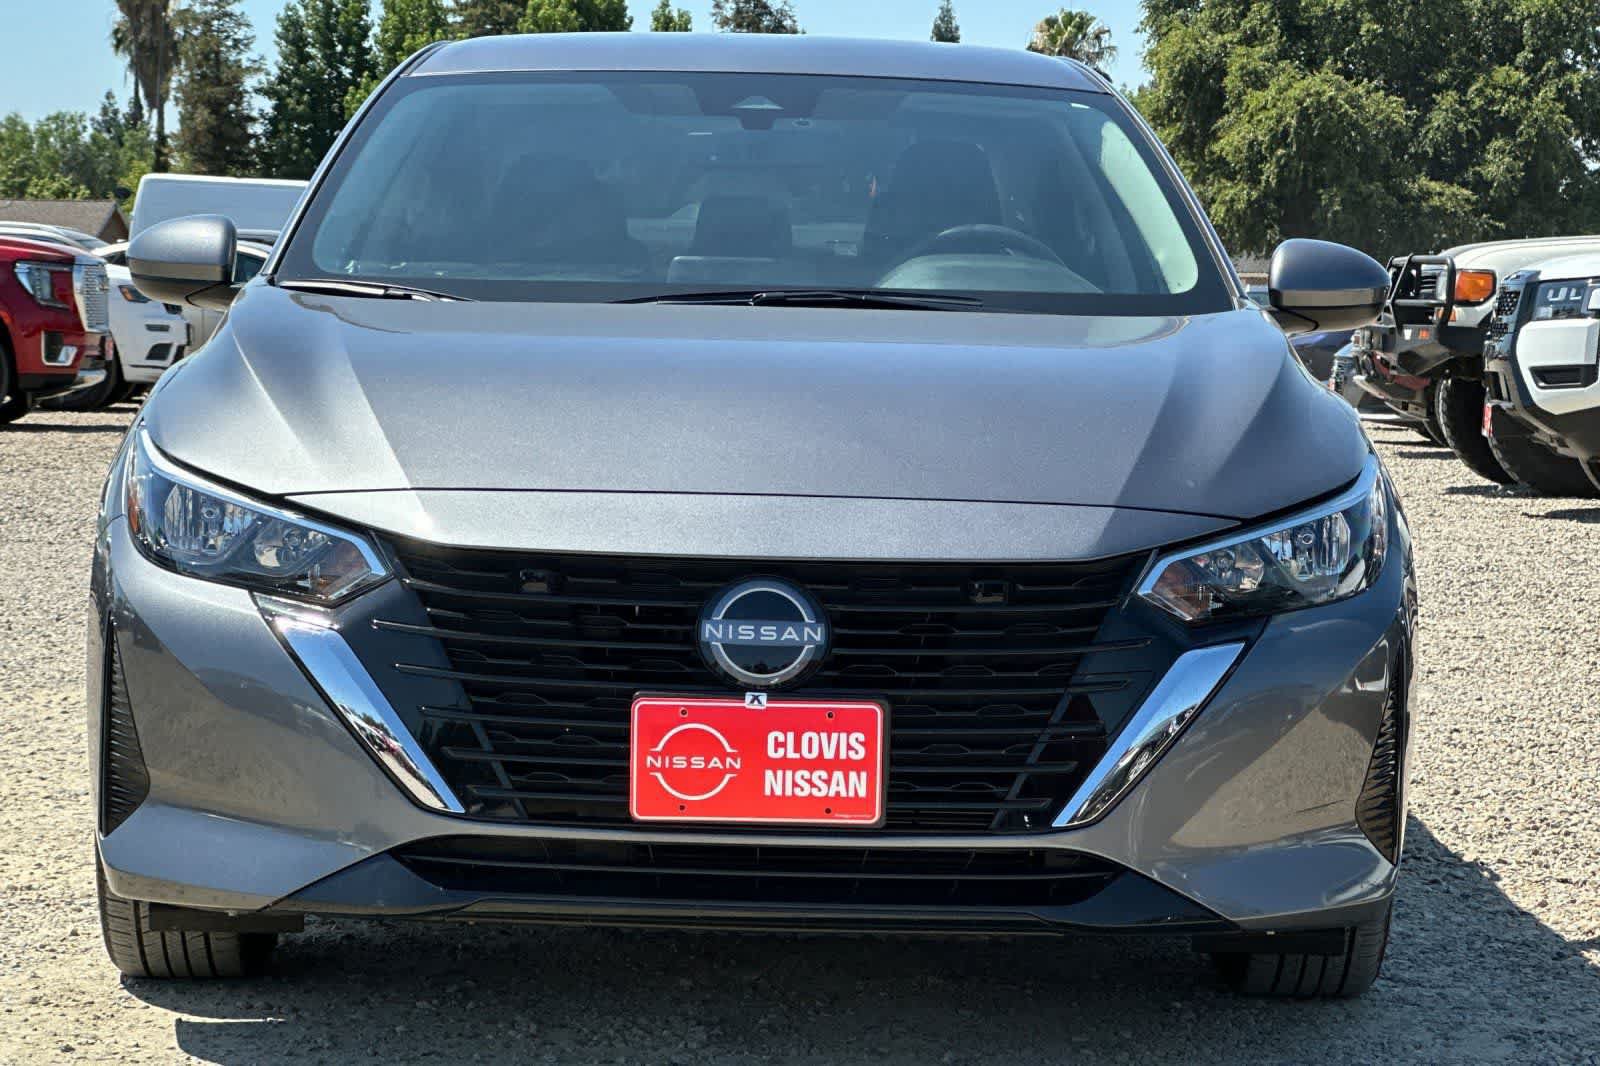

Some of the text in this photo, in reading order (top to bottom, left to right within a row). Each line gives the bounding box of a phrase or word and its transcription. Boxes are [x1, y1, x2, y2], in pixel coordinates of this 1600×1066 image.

[705, 623, 822, 642] NISSAN
[767, 731, 865, 760] CLOVIS
[646, 755, 741, 769] NISSAN
[764, 769, 867, 798] NISSAN
